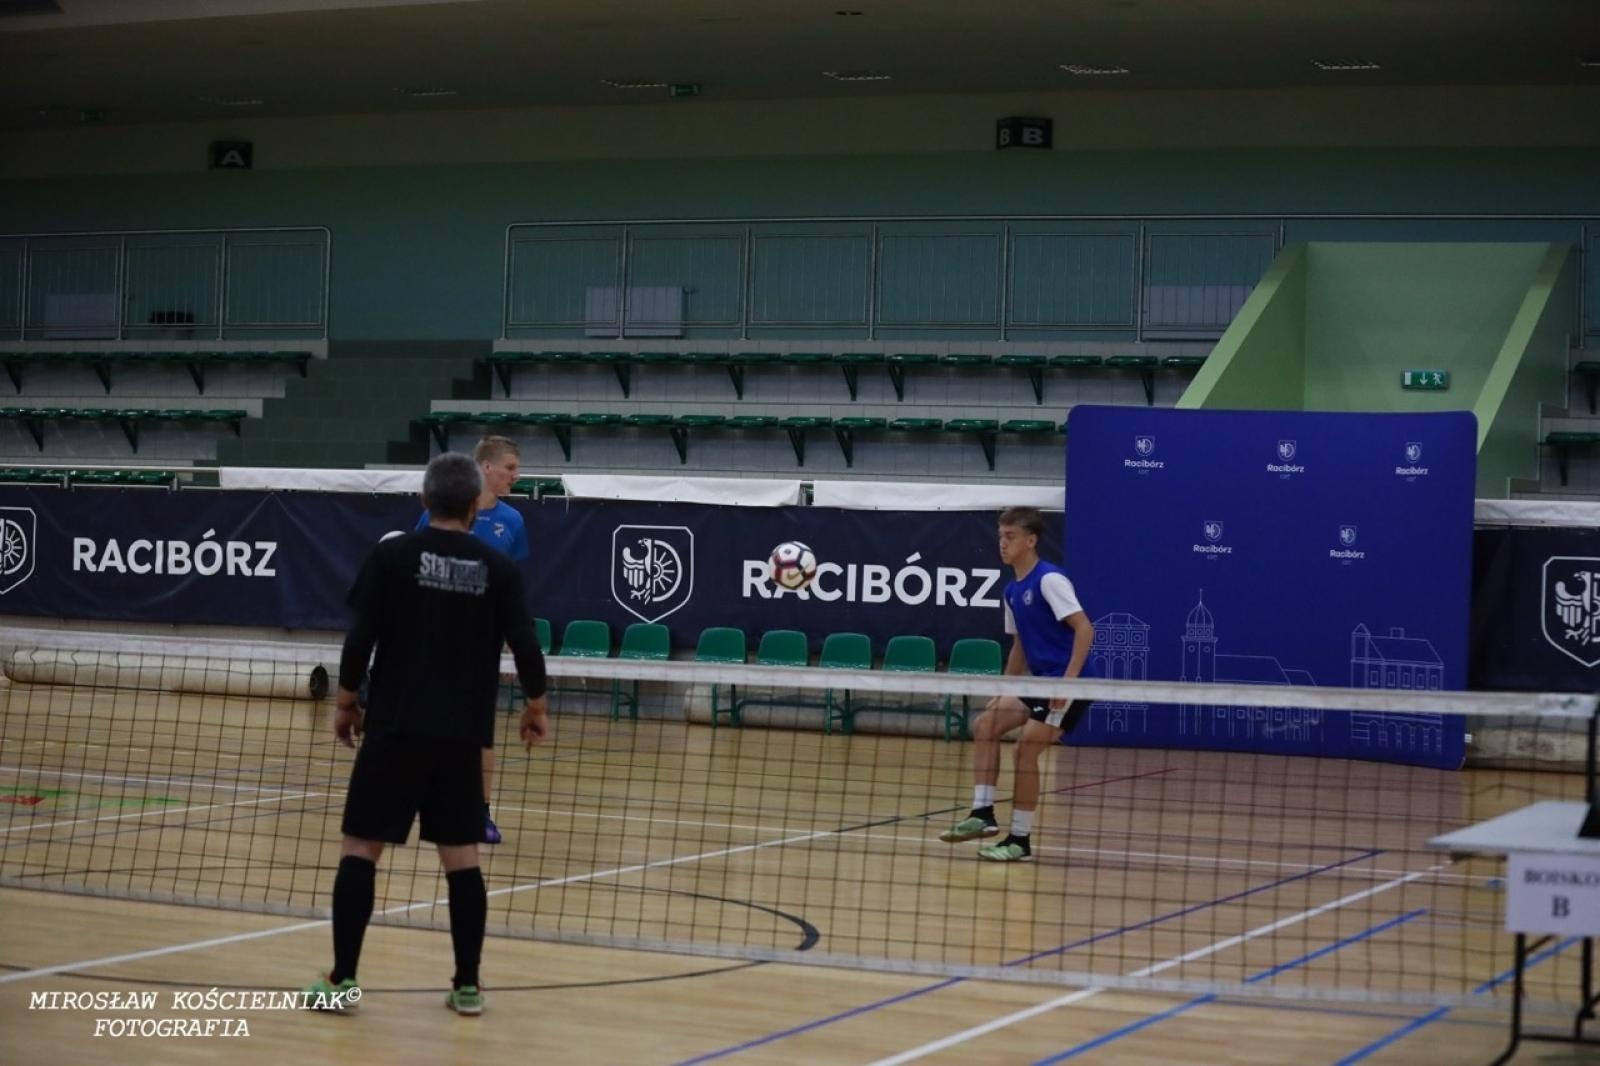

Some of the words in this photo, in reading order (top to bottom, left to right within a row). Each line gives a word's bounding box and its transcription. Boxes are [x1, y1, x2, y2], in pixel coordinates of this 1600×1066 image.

[1000, 128, 1010, 146] B
[1022, 127, 1043, 145] B
[221, 150, 245, 166] A
[1124, 459, 1164, 469] Racibórz
[1267, 464, 1304, 473] Racibórz
[1395, 466, 1428, 475] Racibórz
[72, 528, 276, 577] RACIBÓRZ
[1193, 544, 1232, 554] Racibórz
[1329, 550, 1365, 560] Racibórz
[1553, 896, 1570, 918] B
